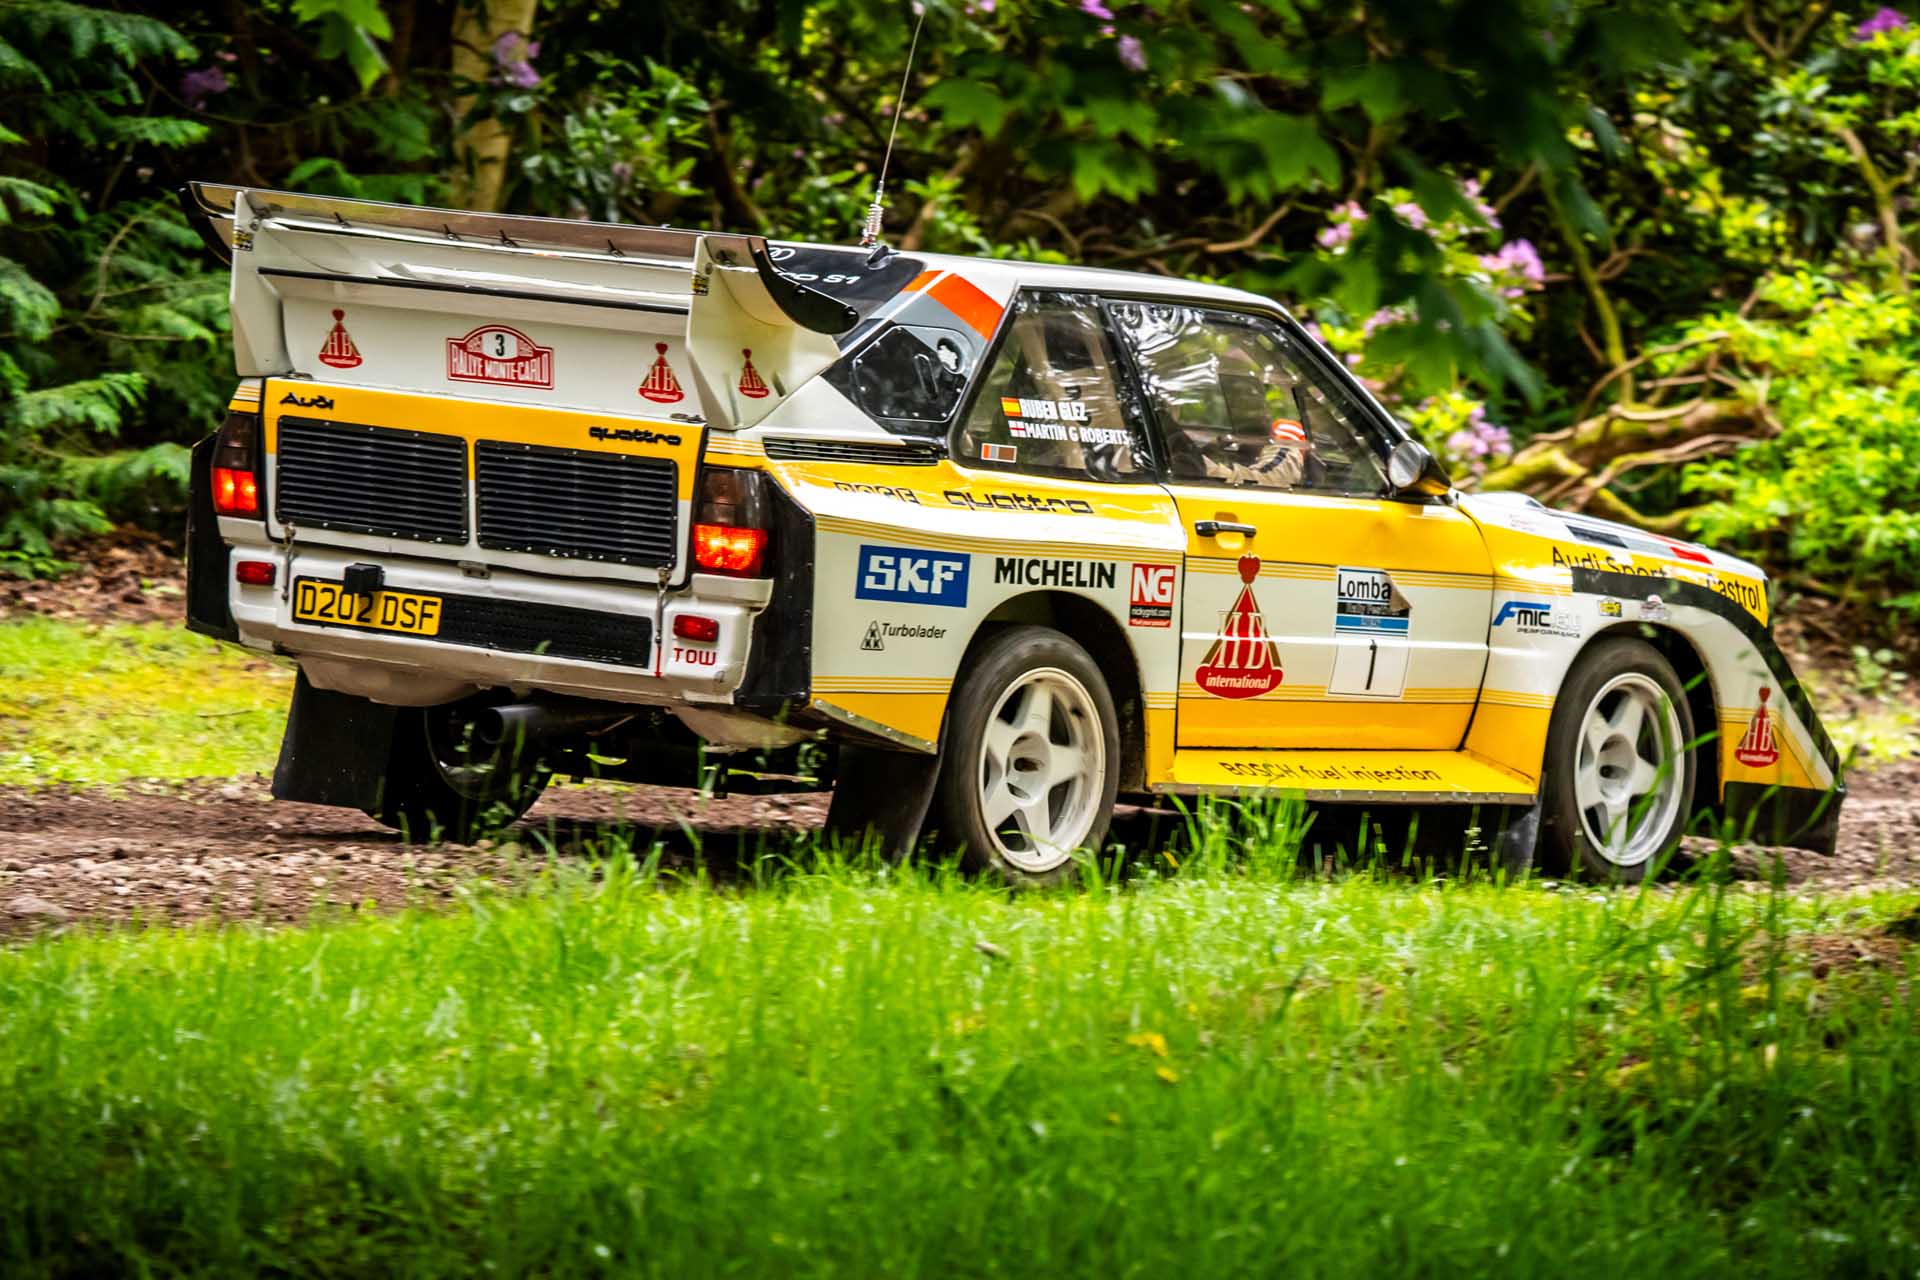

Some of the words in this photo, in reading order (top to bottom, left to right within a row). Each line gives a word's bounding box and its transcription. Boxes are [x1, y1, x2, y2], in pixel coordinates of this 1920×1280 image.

[494, 333, 505, 357] 3
[450, 342, 483, 378] RALLYE
[279, 391, 335, 410] Audi
[1058, 401, 1088, 421] GLEZ
[589, 426, 682, 446] quattro
[1025, 422, 1068, 441] MARTIN
[1068, 426, 1079, 442] G
[1080, 427, 1130, 446] ROBERTS
[942, 489, 1095, 513] quattro
[864, 555, 963, 595] SKF
[994, 557, 1116, 589] MICHELIN
[1132, 567, 1174, 603] NG
[300, 584, 374, 624] D202
[381, 595, 438, 630] DSF
[882, 623, 946, 639] Turbolader
[673, 647, 717, 666] TOW
[1364, 639, 1378, 691] 1
[1206, 672, 1272, 689] international
[1299, 765, 1344, 780] fuel
[1343, 766, 1443, 783] injection
